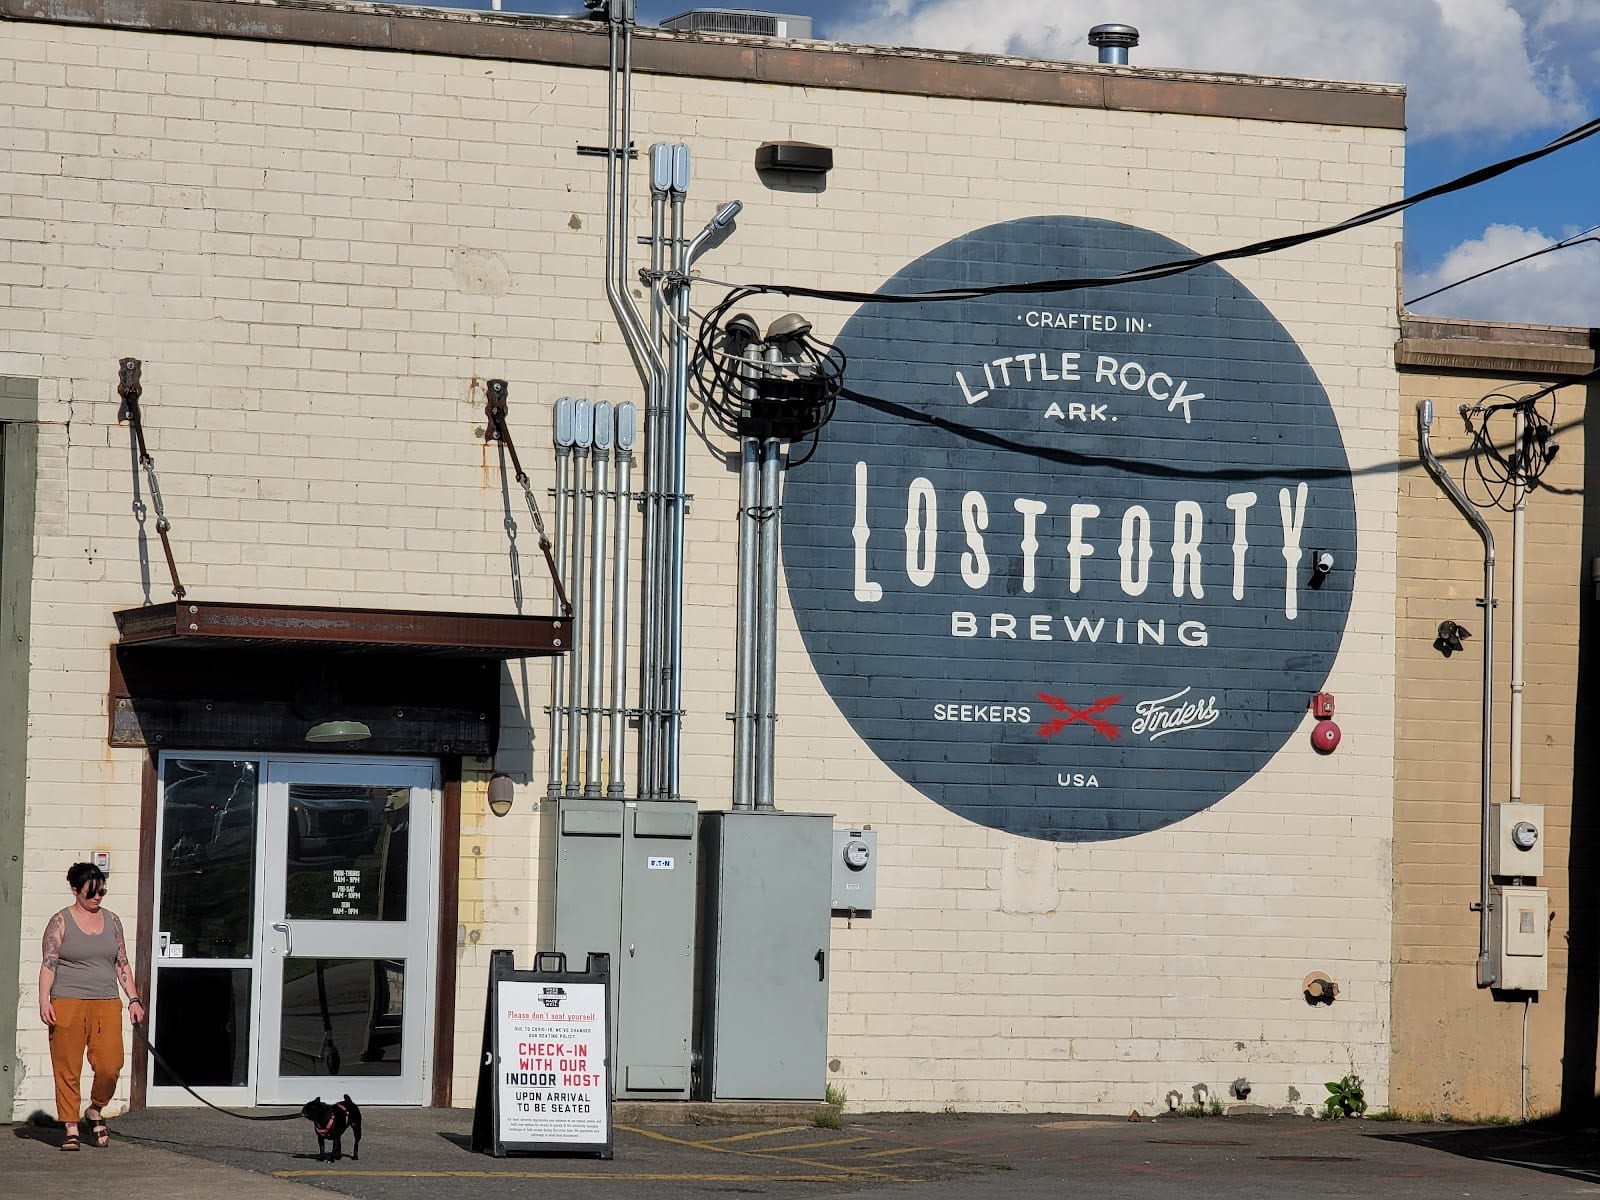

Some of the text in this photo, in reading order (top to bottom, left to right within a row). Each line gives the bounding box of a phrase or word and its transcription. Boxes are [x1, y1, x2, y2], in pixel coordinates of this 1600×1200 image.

[1025, 311, 1145, 333] CRAFTED IN
[955, 352, 1206, 424] LITTLE ROCK
[1043, 401, 1118, 423] ARK.
[951, 611, 1209, 647] BREWING
[933, 686, 1220, 742] SEEKERS Finders
[1057, 772, 1099, 788] USA
[507, 1010, 530, 1019] Please
[532, 1011, 549, 1020] don't
[551, 1012, 566, 1020] seat
[518, 1042, 588, 1057] CHECK-IN
[519, 1058, 587, 1073] WITH OUR
[506, 1073, 601, 1088] INDOOR HOST
[515, 1092, 591, 1103] UPON ARRIVAL
[517, 1103, 591, 1114] TO BE SEATED
